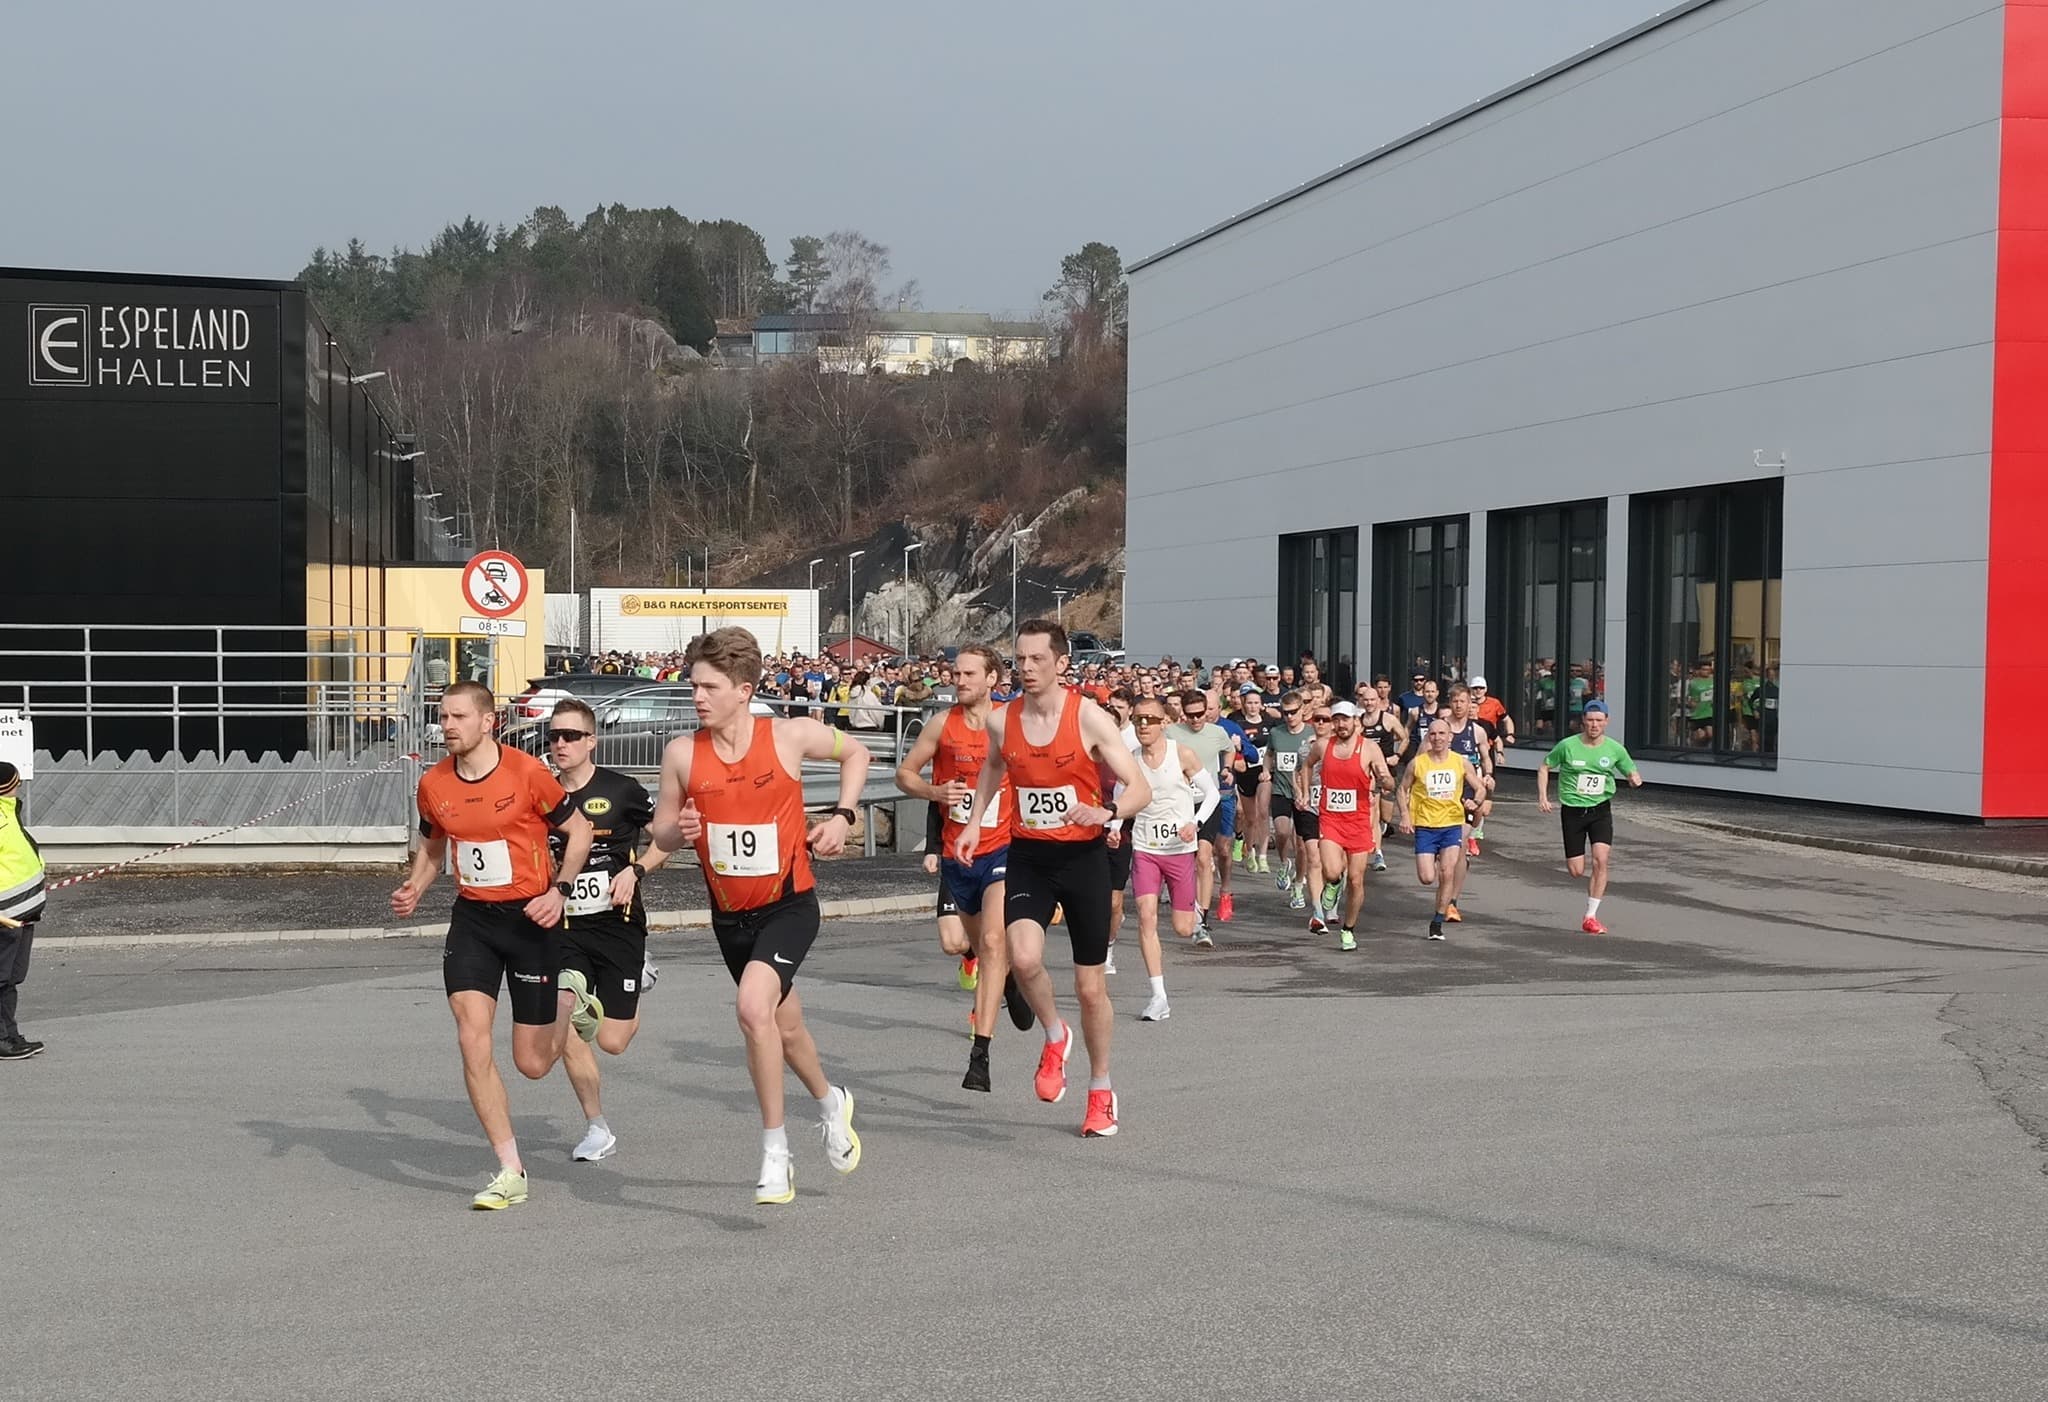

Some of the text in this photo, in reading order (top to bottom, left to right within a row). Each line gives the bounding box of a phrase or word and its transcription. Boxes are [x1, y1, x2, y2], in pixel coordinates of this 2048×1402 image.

[99, 306, 250, 351] ESPELAND
[98, 358, 250, 387] HALLEN
[643, 600, 787, 610] B&G RACKETSPORTSENTER
[478, 621, 508, 632] 08-15
[1283, 754, 1295, 765] 64
[1432, 772, 1451, 785] 170
[1586, 776, 1599, 788] 79
[1028, 792, 1067, 814] 258
[1331, 791, 1352, 804] 230
[1152, 823, 1178, 839] 164
[726, 830, 756, 857] 19
[472, 847, 485, 871] 3
